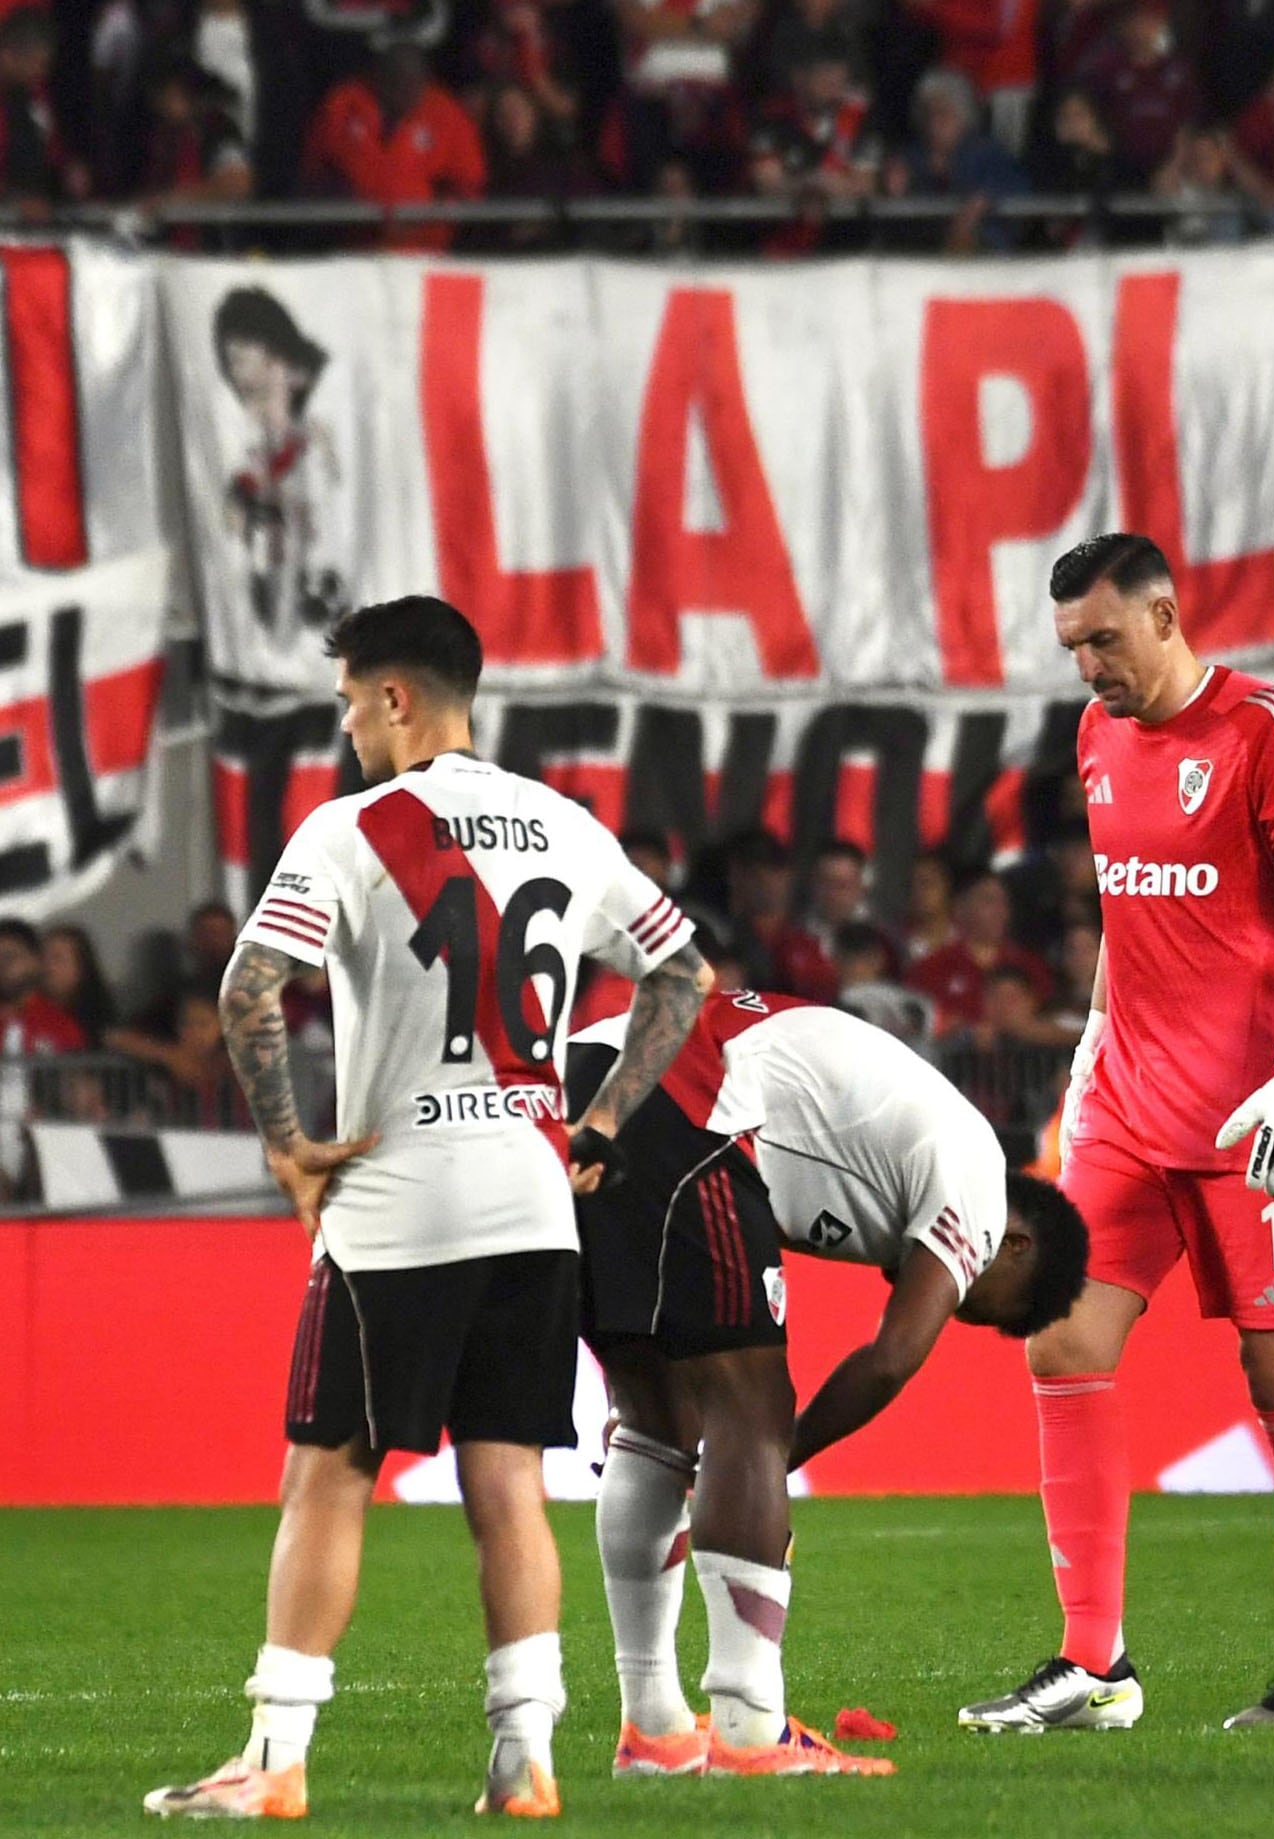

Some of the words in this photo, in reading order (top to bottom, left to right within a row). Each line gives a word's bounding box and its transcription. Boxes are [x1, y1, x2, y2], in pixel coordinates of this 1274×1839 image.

[419, 272, 820, 680] LA
[432, 815, 550, 853] BUSTOS
[1093, 853, 1219, 897] Betano
[409, 876, 573, 1065] 16
[415, 1089, 558, 1126] DIRECTV
